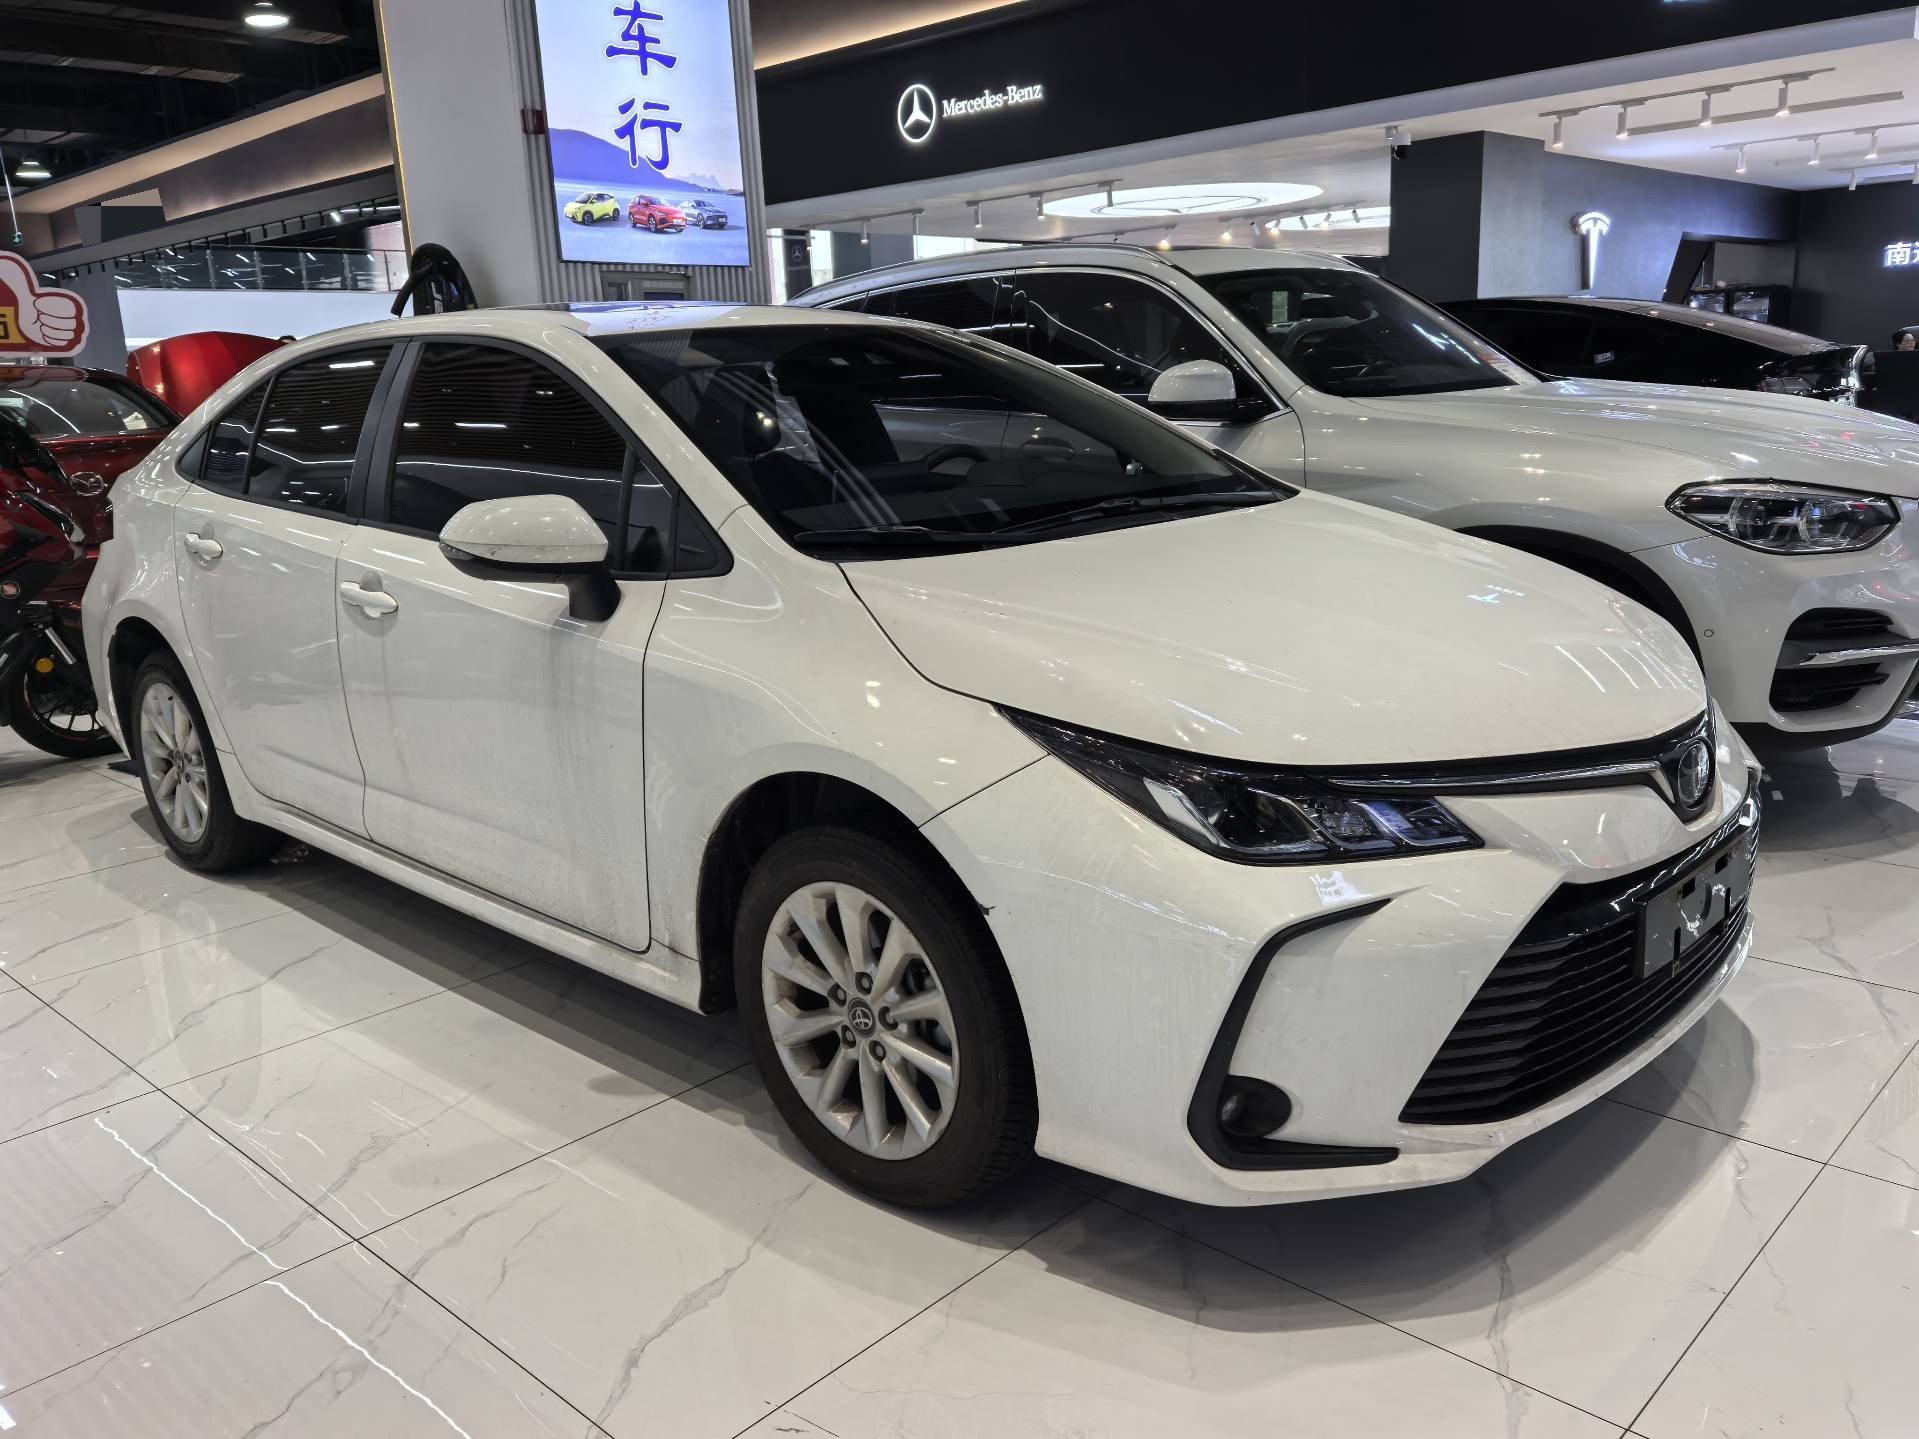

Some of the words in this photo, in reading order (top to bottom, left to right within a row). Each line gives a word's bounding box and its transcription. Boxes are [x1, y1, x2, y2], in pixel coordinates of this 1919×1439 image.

[606, 0, 683, 170] 车行
[942, 84, 1043, 118] Mercedes-Benz
[1885, 241, 1919, 266] 南
